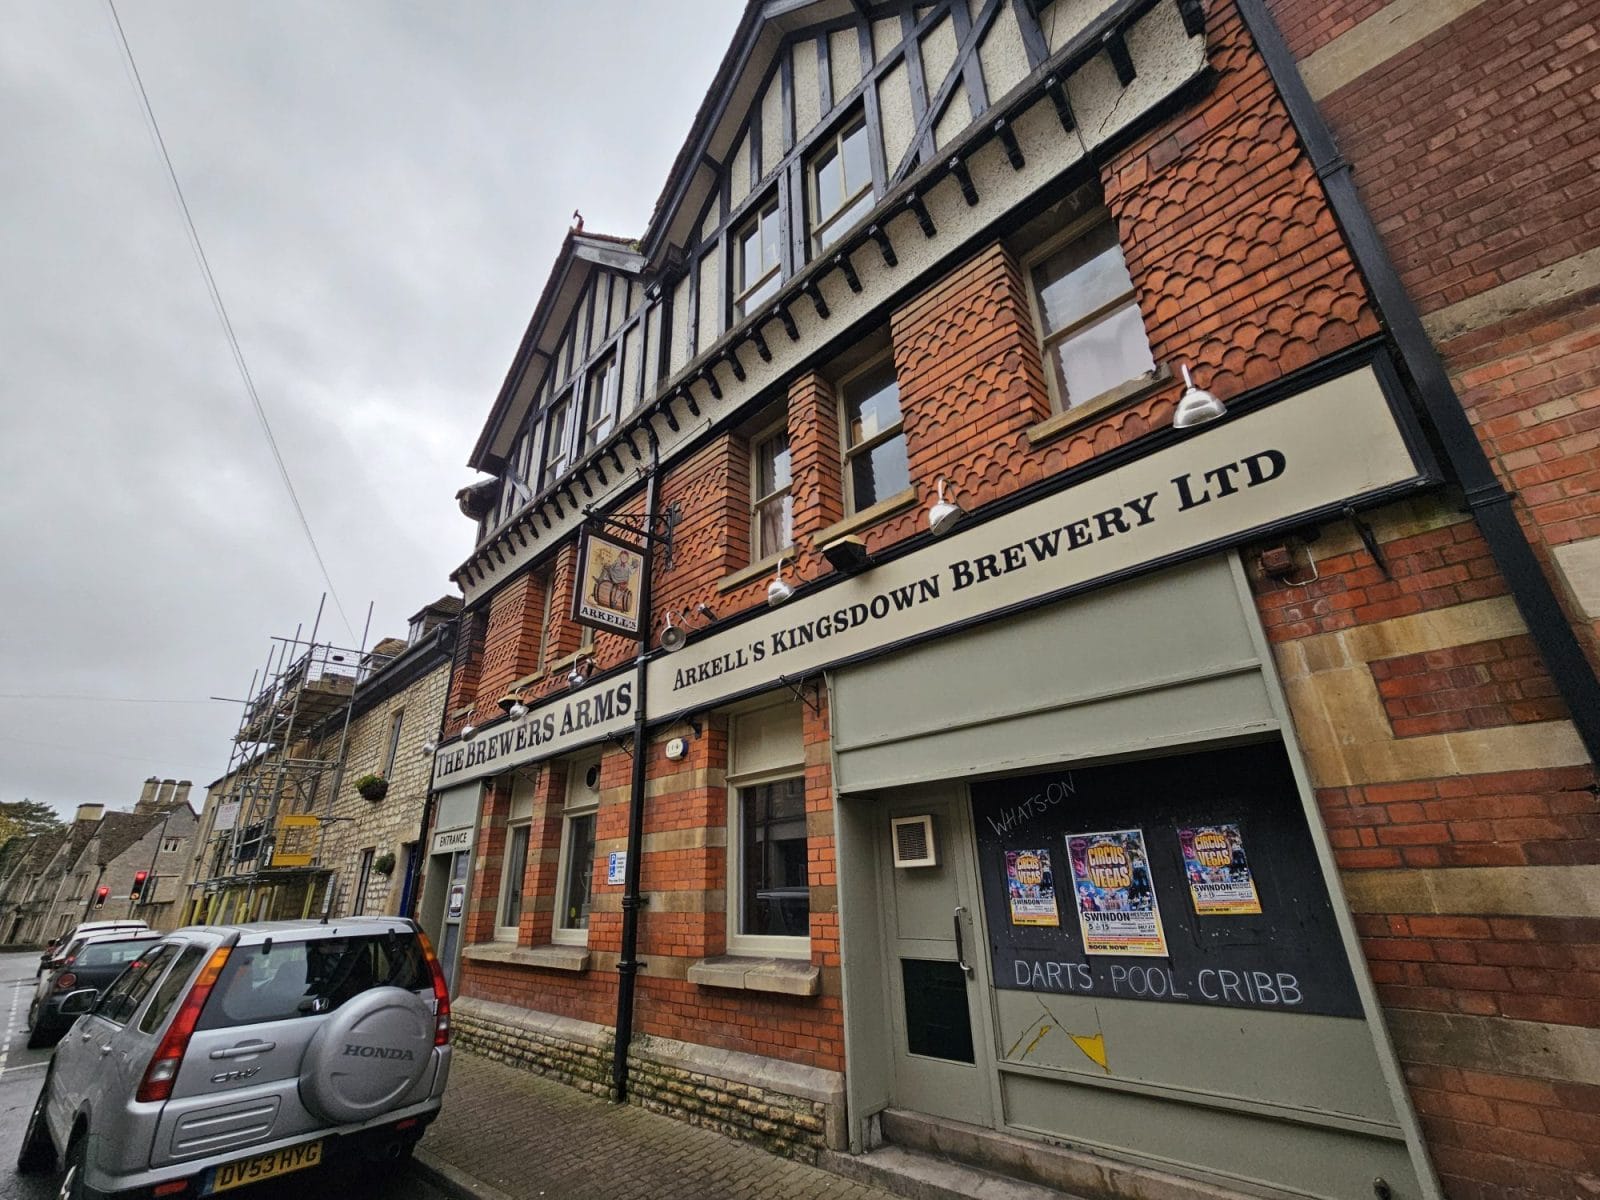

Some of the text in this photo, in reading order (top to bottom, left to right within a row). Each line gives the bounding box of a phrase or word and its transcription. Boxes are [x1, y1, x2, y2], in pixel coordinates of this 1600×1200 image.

[672, 448, 1287, 692] ARKELL'S KINGSDOWN BREWERY LTD
[581, 606, 638, 630] ARKELL'S
[436, 680, 633, 779] THE BREWERS ARMS
[439, 831, 468, 848] ENTRANCE
[1193, 834, 1228, 851] CIRCUS
[1087, 845, 1127, 866] CIRCUS
[1197, 848, 1232, 867] VEGAS
[1091, 865, 1132, 888] VEGAS
[1194, 883, 1234, 893] SWINDON
[1011, 898, 1041, 906] SWINDON
[1084, 912, 1131, 922] SWINDON
[1014, 959, 1303, 1005] DARTS POOL CRIBB
[341, 1043, 415, 1061] HONDA
[219, 1142, 321, 1187] DV53 HYG
